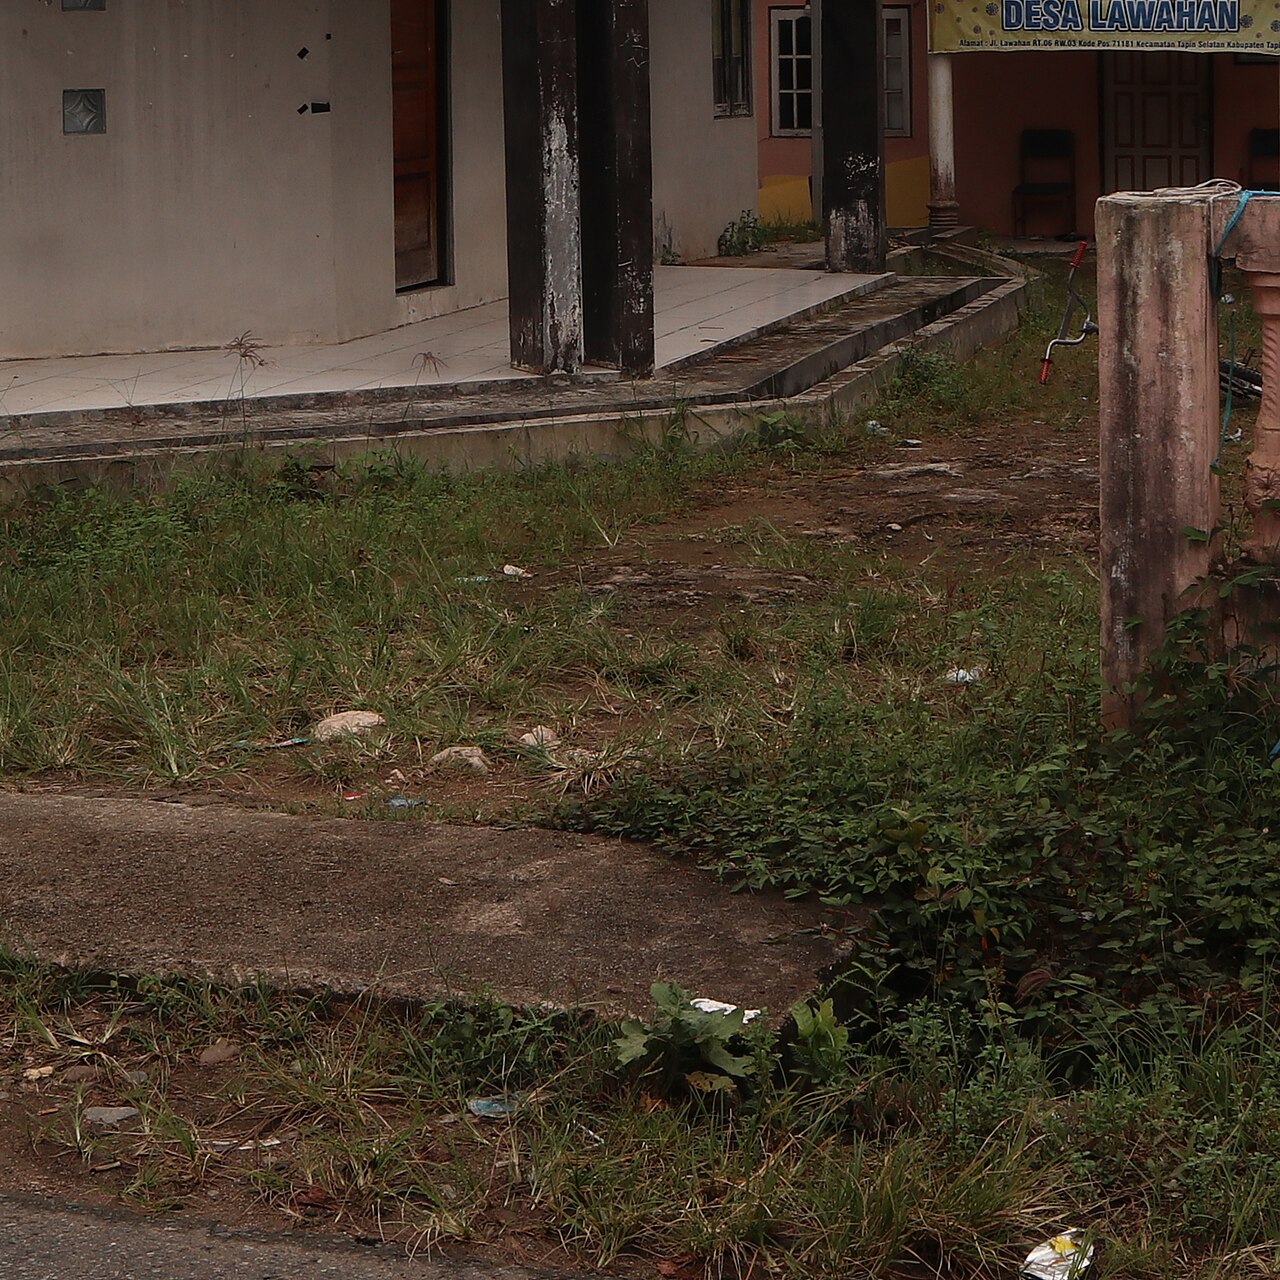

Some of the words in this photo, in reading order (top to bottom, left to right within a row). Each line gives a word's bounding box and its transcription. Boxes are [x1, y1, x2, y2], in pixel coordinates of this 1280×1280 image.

[959, 39, 983, 47] Alamat
[1000, 39, 1030, 47] Lawahan
[1079, 39, 1095, 47] Kode
[1136, 40, 1175, 48] Kecamatan
[1178, 40, 1196, 49] Tapin
[1227, 41, 1264, 49] Kabupaten
